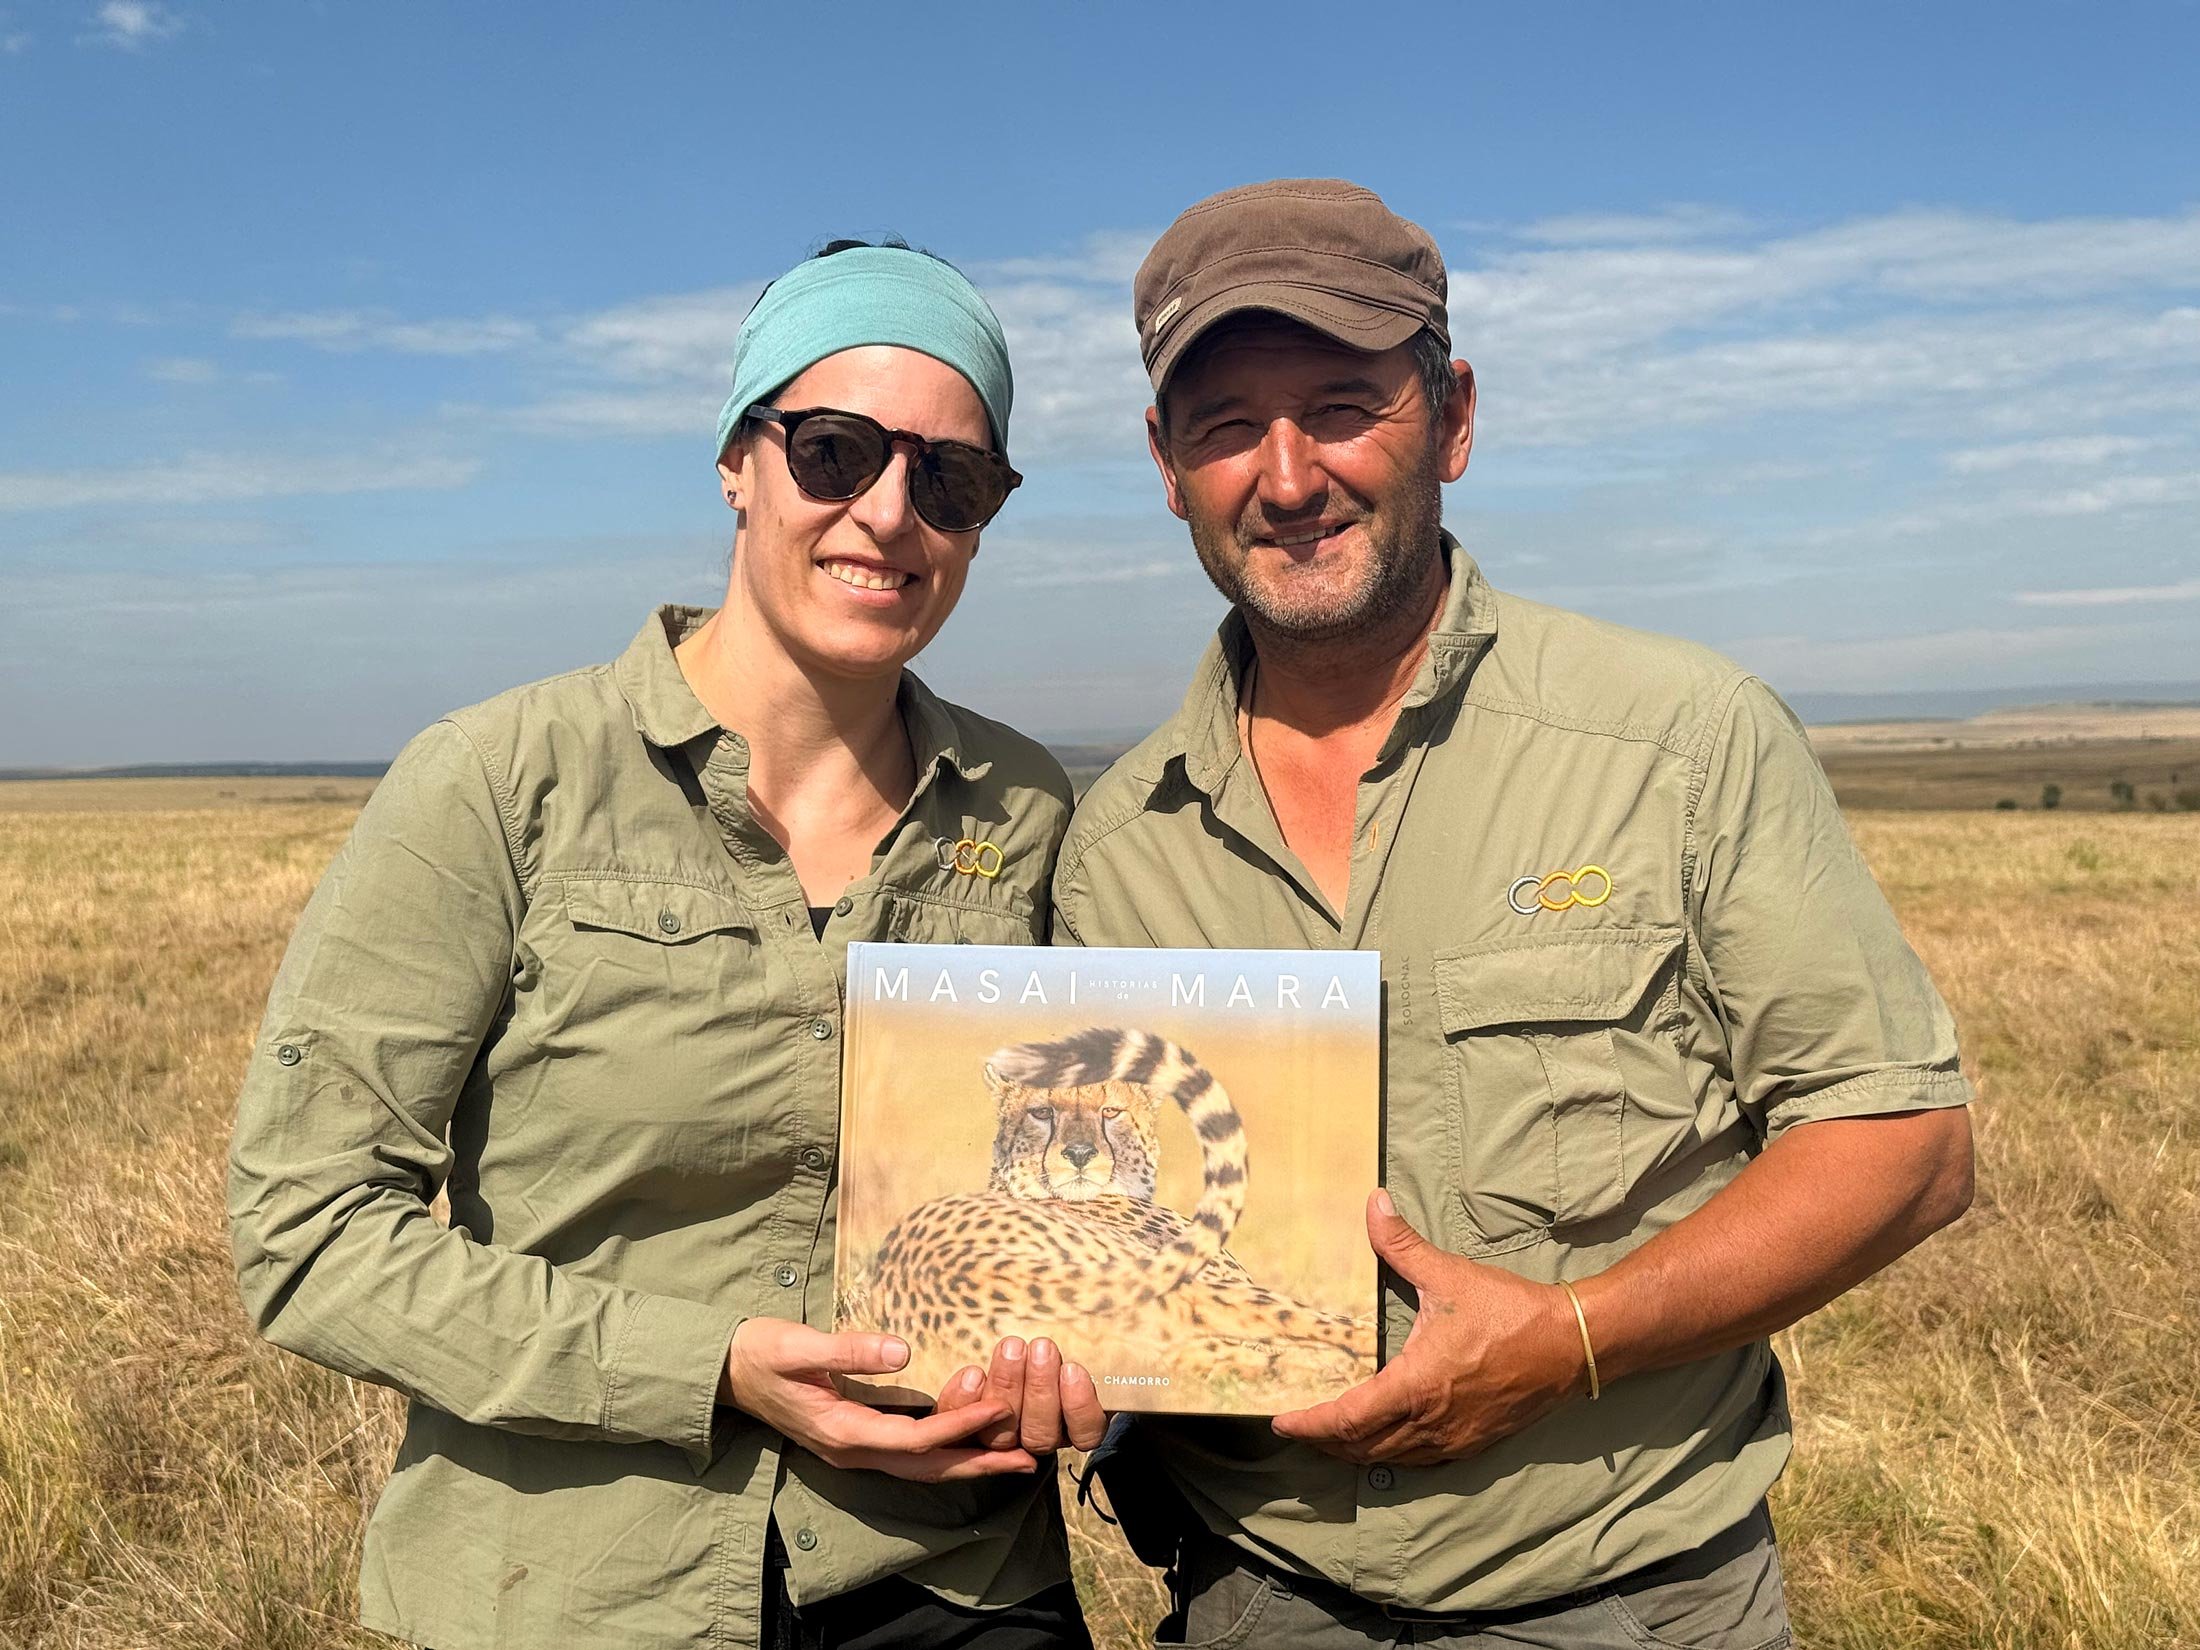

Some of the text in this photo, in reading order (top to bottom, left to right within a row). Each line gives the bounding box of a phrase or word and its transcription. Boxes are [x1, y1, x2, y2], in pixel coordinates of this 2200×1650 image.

[874, 967, 1352, 1010] MASAI MARA
[1089, 979, 1158, 989] HISTORIAS
[1116, 991, 1129, 1000] de
[1400, 955, 1413, 1026] SOLOGNAC
[1104, 1375, 1170, 1386] CHAMORRO
